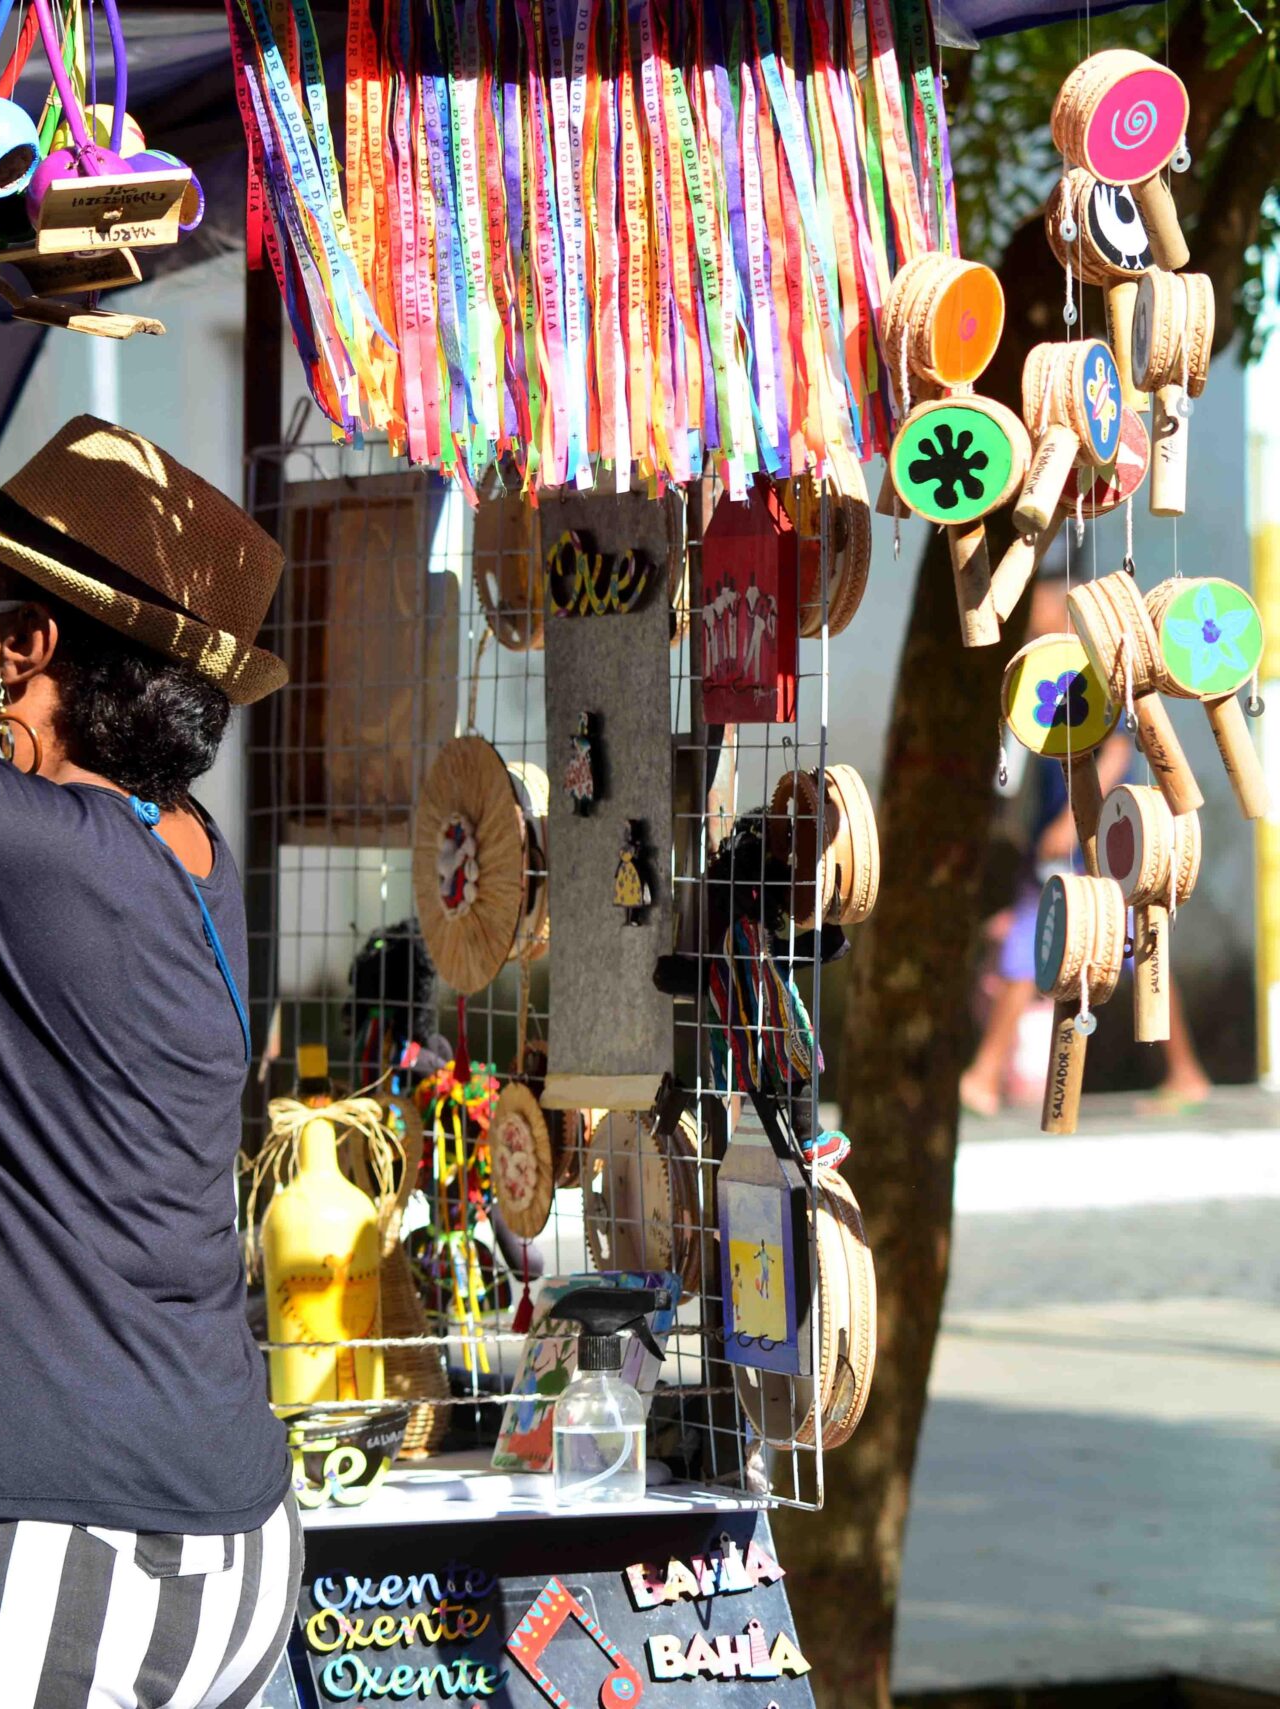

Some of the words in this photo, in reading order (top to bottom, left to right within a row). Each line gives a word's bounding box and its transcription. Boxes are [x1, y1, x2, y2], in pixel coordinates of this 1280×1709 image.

[578, 9, 588, 31] DO
[304, 39, 321, 112] SENHOR
[316, 123, 327, 145] DO
[348, 68, 358, 90] DO
[369, 91, 378, 114] DO
[571, 42, 586, 113] SENHOR
[348, 102, 359, 171] BONFIM
[427, 105, 437, 127] DO
[452, 109, 460, 131] DO
[571, 126, 580, 147] DO
[624, 109, 633, 131] DO
[677, 105, 689, 127] DO
[276, 80, 290, 102] DO
[287, 112, 316, 180] BONFIM
[311, 189, 324, 212] DA
[370, 126, 382, 194] BONFIM
[682, 138, 704, 205] BONFIM
[347, 183, 357, 204] DA
[401, 161, 413, 229] BONFIM
[420, 158, 432, 226] BONFIM
[437, 88, 447, 111] DO
[453, 237, 464, 292] BAHIA
[460, 137, 475, 206] BONFIM
[468, 217, 478, 239] DA
[625, 142, 636, 210] BONFIM
[670, 142, 683, 210] BONFIM
[701, 143, 713, 210] BONFIM
[333, 210, 346, 232] DA
[419, 237, 427, 258] DA
[438, 219, 448, 240] DA
[629, 222, 639, 242] DA
[674, 222, 684, 244] DA
[696, 215, 708, 237] DA
[750, 223, 760, 243] DA
[405, 242, 414, 264] DA
[439, 249, 450, 306] BAHIA
[540, 243, 549, 264] DA
[567, 255, 575, 276] DA
[702, 247, 717, 301] BAHIA
[405, 274, 416, 330] BAHIA
[419, 270, 431, 323] BAHIA
[543, 275, 558, 331] BAHIA
[631, 254, 640, 308] BAHIA
[752, 255, 766, 309] BAHIA
[815, 275, 830, 328] BAHIA
[568, 287, 579, 343] BAHIA
[313, 1558, 498, 1610] Oxente
[625, 1532, 787, 1609] BAHIA
[307, 1599, 490, 1650] Oxente
[648, 1618, 812, 1679] BAHIA
[323, 1651, 510, 1698] Oxente
